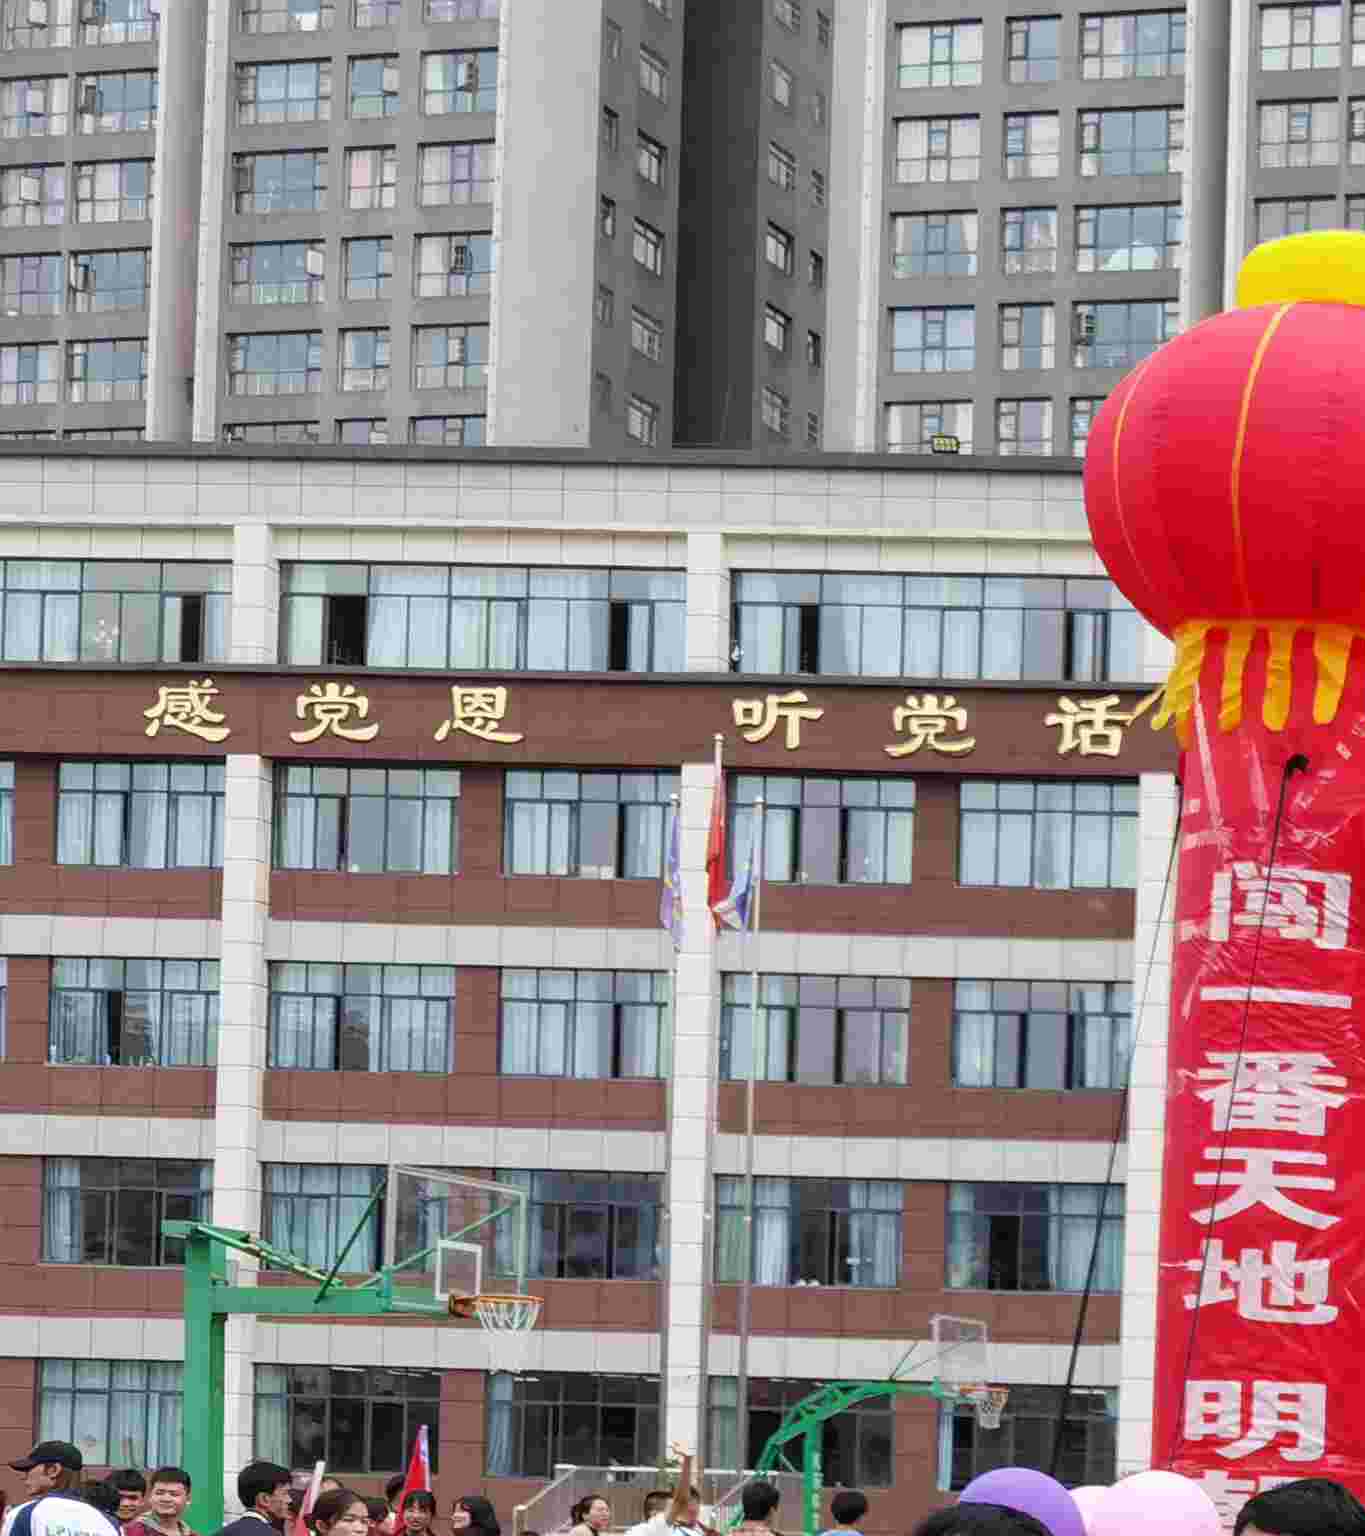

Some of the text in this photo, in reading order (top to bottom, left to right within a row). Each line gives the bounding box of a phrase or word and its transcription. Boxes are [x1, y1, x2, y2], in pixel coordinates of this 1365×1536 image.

[144, 678, 1130, 757] 感党恩 听党话
[1183, 861, 1352, 1326] 闯一番天地
